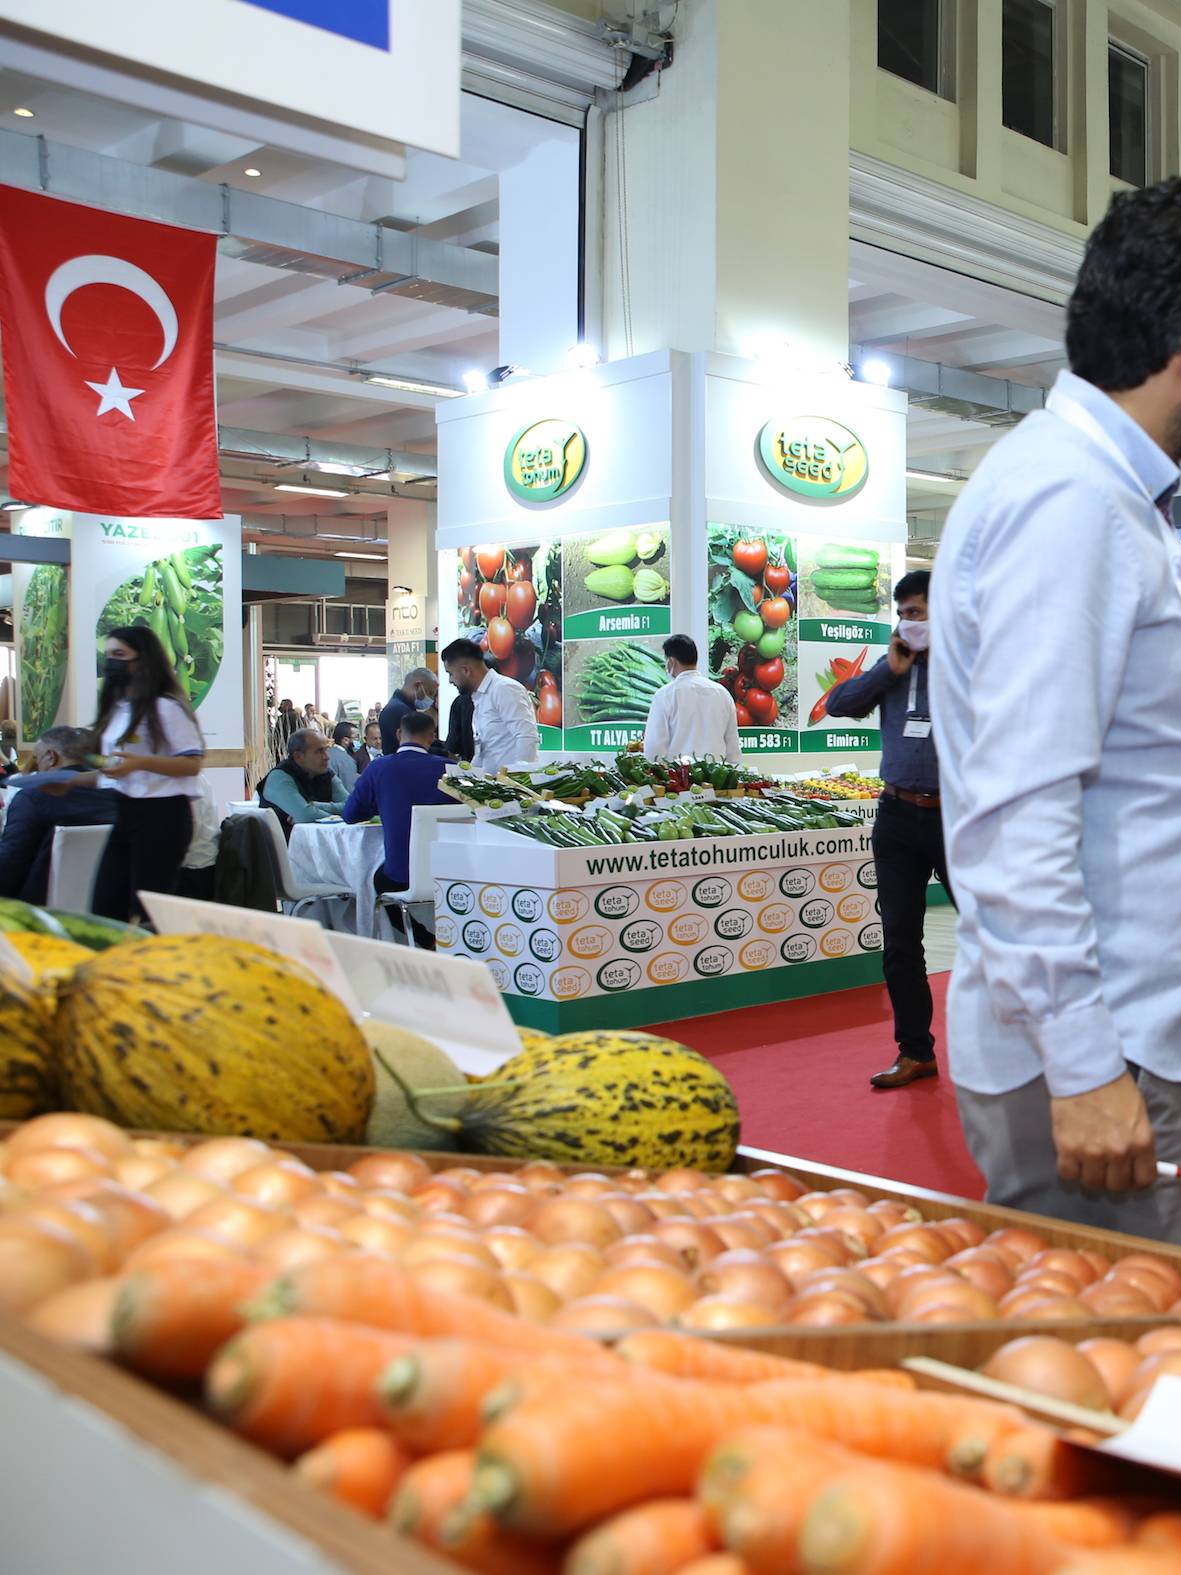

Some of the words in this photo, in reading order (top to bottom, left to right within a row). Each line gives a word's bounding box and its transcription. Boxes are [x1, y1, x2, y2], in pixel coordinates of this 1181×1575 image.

[783, 457, 833, 483] seed
[599, 613, 640, 632] Arsemia
[641, 616, 650, 629] F1
[820, 623, 864, 640] Yeşilgöz
[865, 629, 873, 639] F1
[590, 729, 602, 746] TT
[603, 729, 628, 746] ALYA
[738, 736, 758, 749] sım
[759, 733, 781, 748] 583
[782, 737, 791, 748] F1
[826, 733, 859, 748] Elmira
[860, 736, 869, 747] F1
[586, 834, 872, 876] www.tetatohumculuk.com.tr
[785, 876, 802, 886] teta
[698, 885, 717, 895] teta
[786, 884, 805, 892] tohum
[450, 892, 464, 901] teta
[602, 896, 622, 907] teta
[700, 893, 720, 902] tohum
[516, 897, 531, 908] teta
[604, 903, 627, 913] tohum
[804, 907, 821, 917] teta
[720, 917, 739, 928] teta
[466, 929, 480, 938] teta
[627, 930, 647, 940] teta
[863, 931, 878, 939] teta
[534, 937, 549, 948] teta
[629, 936, 650, 946] seed
[786, 942, 803, 951] teta
[788, 949, 806, 958] tohum
[699, 954, 718, 964] teta
[701, 962, 721, 971] tohum
[518, 972, 533, 982] teta
[604, 968, 624, 979] teta
[606, 976, 628, 986] tohum
